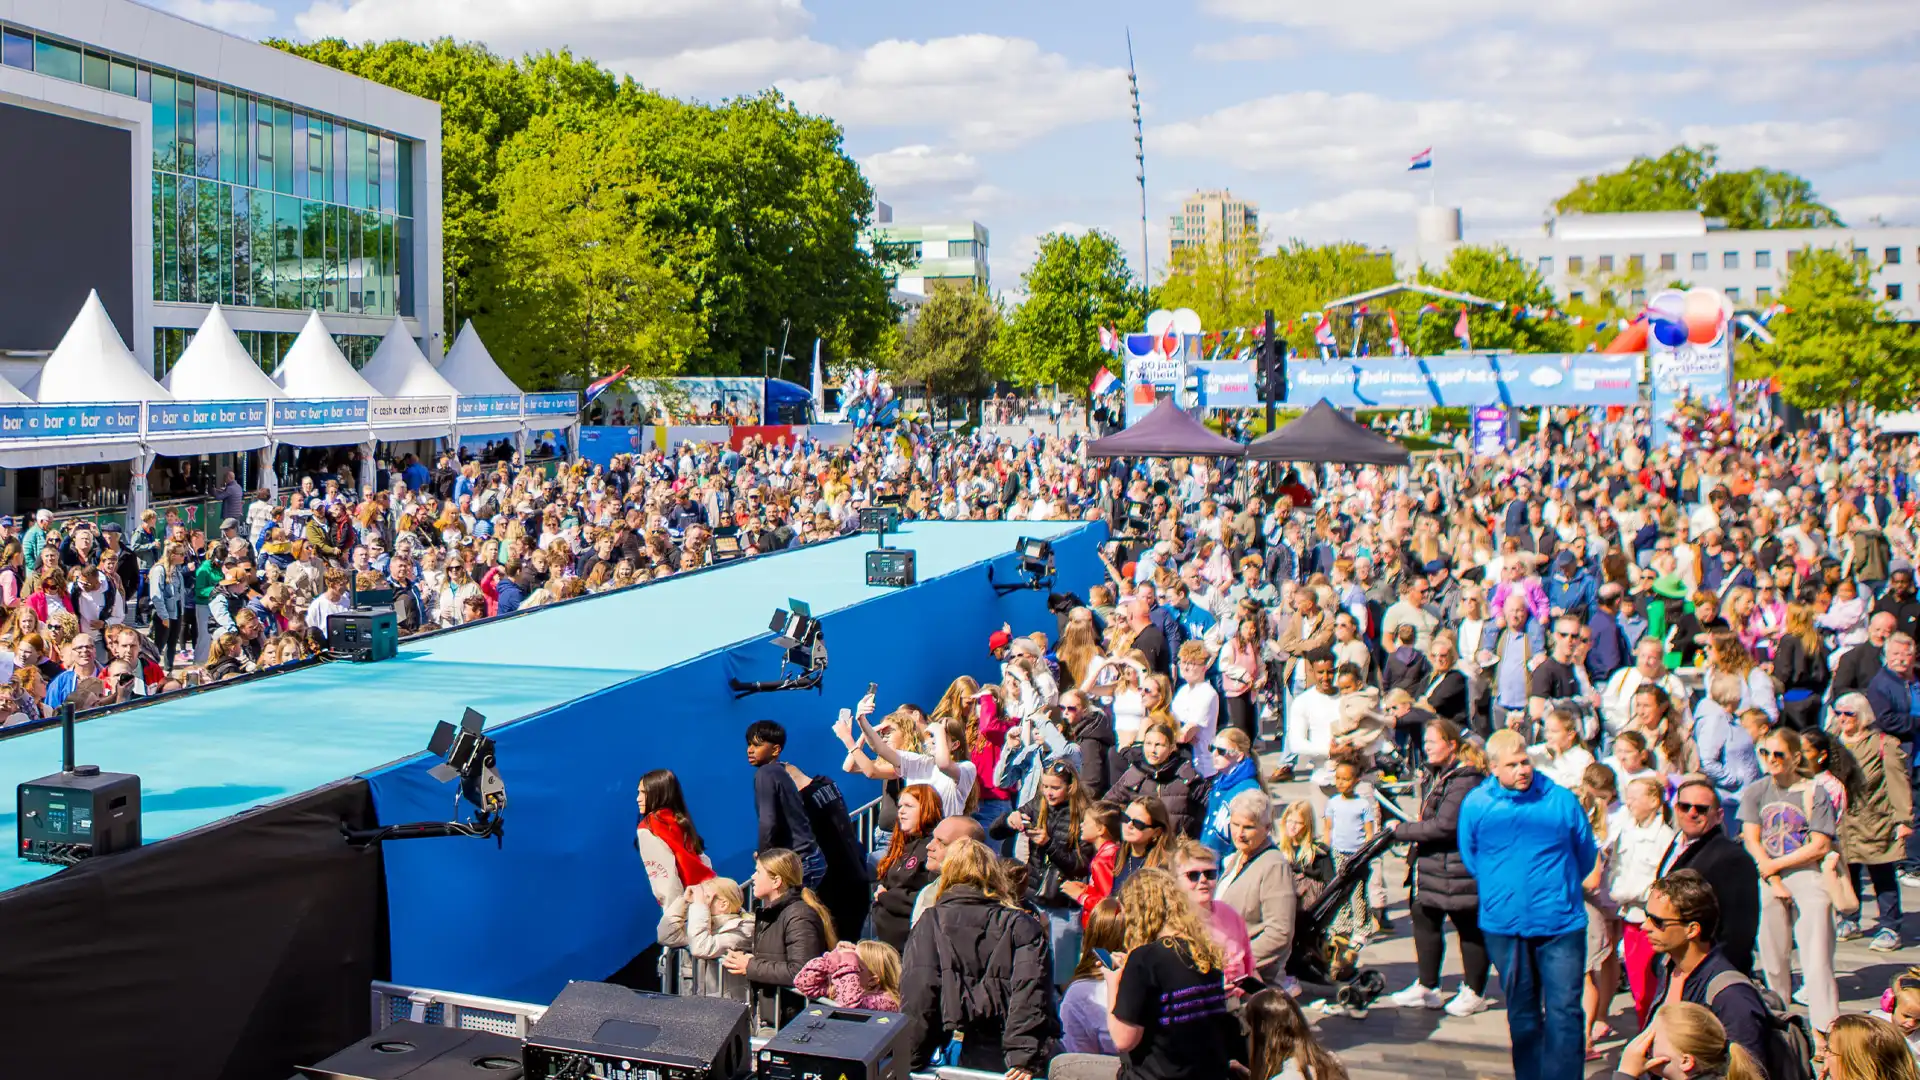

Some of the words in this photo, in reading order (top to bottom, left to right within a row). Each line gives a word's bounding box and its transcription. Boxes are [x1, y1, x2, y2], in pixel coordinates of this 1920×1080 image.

[1157, 361, 1180, 371] jaar
[162, 409, 178, 424] bar
[193, 408, 209, 423] bar
[219, 408, 236, 422] bar
[249, 407, 263, 421] bar
[284, 406, 297, 420] bar
[308, 406, 322, 419] bar
[331, 405, 344, 418] bar
[354, 404, 365, 417] bar
[379, 404, 392, 416] cash
[399, 403, 412, 415] cash
[418, 404, 430, 415] cash
[436, 403, 449, 414] cash
[3, 414, 23, 430] bar
[43, 412, 64, 429] bar
[81, 411, 100, 427] bar
[117, 411, 136, 426] bar
